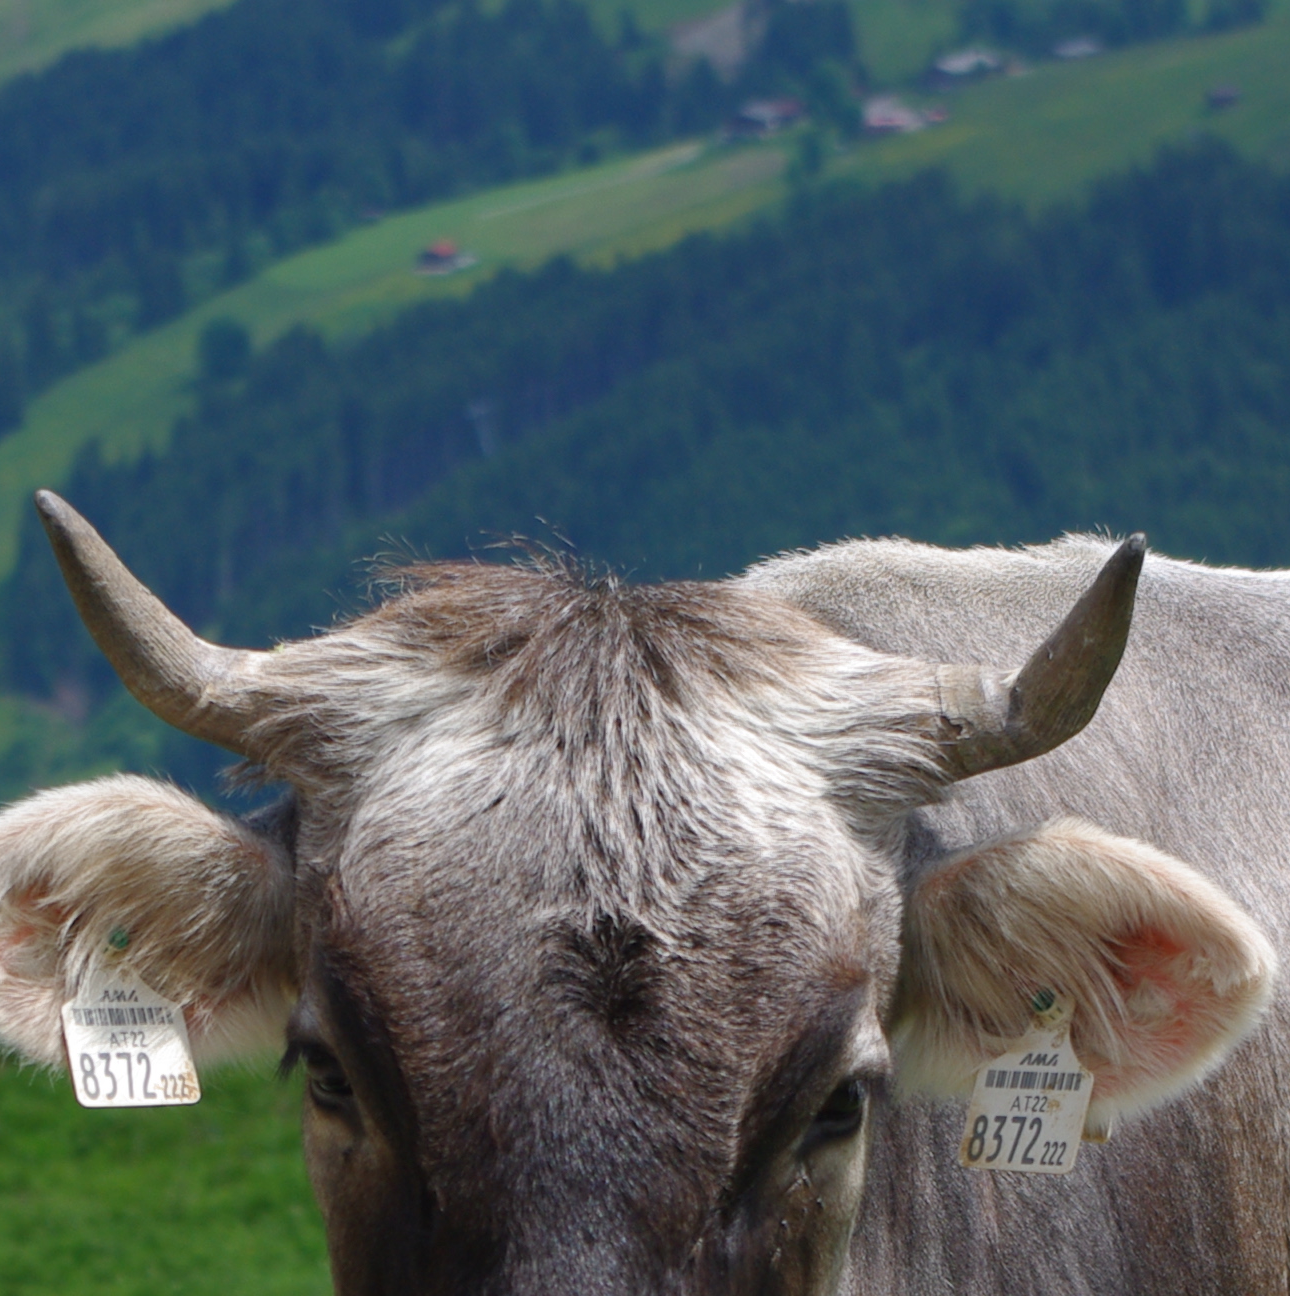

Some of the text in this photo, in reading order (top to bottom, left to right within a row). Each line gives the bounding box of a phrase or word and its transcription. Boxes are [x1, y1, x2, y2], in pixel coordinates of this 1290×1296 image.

[109, 1031, 149, 1047] AT22
[80, 1052, 188, 1100] 8372 222
[1010, 1096, 1048, 1113] AT22
[967, 1115, 1067, 1166] 8372 222
